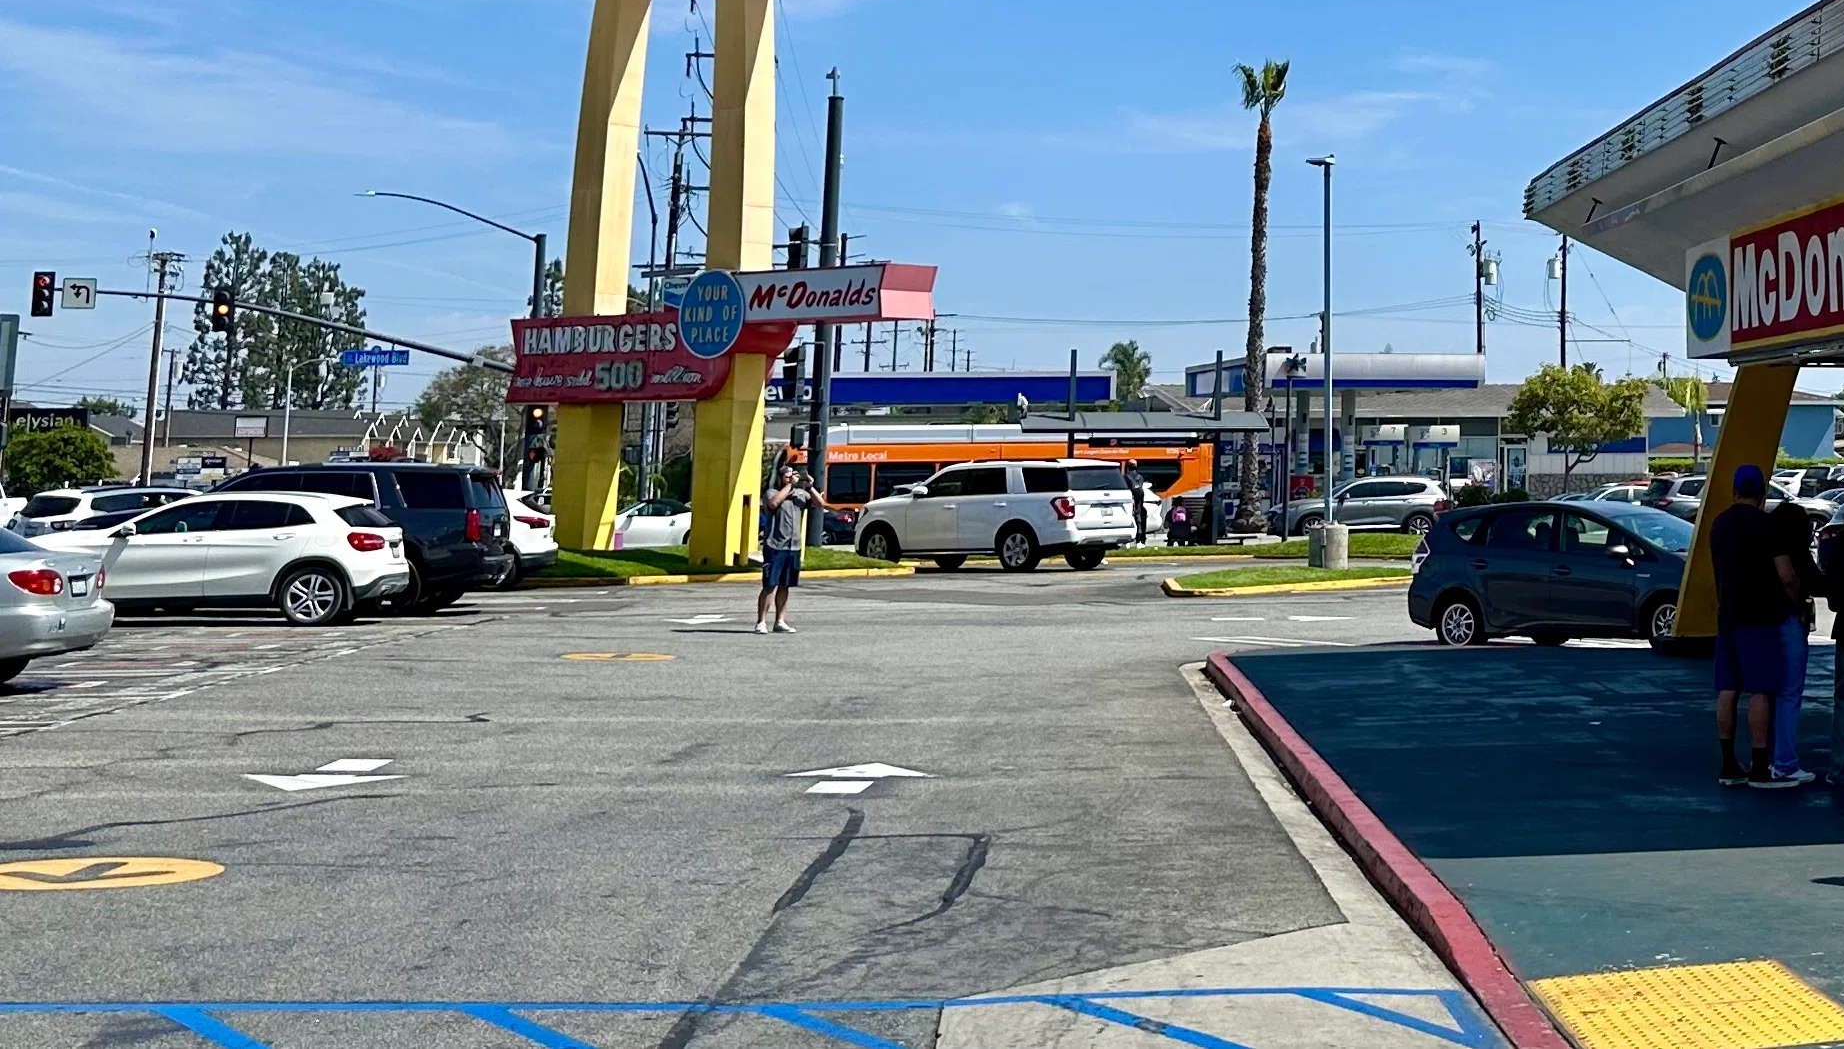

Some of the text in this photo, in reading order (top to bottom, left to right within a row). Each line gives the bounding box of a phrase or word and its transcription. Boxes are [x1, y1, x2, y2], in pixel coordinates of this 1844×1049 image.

[698, 285, 728, 301] YOUR
[749, 278, 877, 311] McDonalds
[684, 304, 738, 323] KIND OF
[523, 322, 677, 355] HAMBURGERS
[691, 326, 729, 344] PLACE
[354, 352, 390, 364] Lakewood
[391, 352, 408, 364] Blvd
[533, 367, 563, 388] have
[566, 369, 592, 387] sold
[594, 359, 644, 391] 500
[650, 365, 702, 385] million
[828, 450, 888, 460] Metro Local
